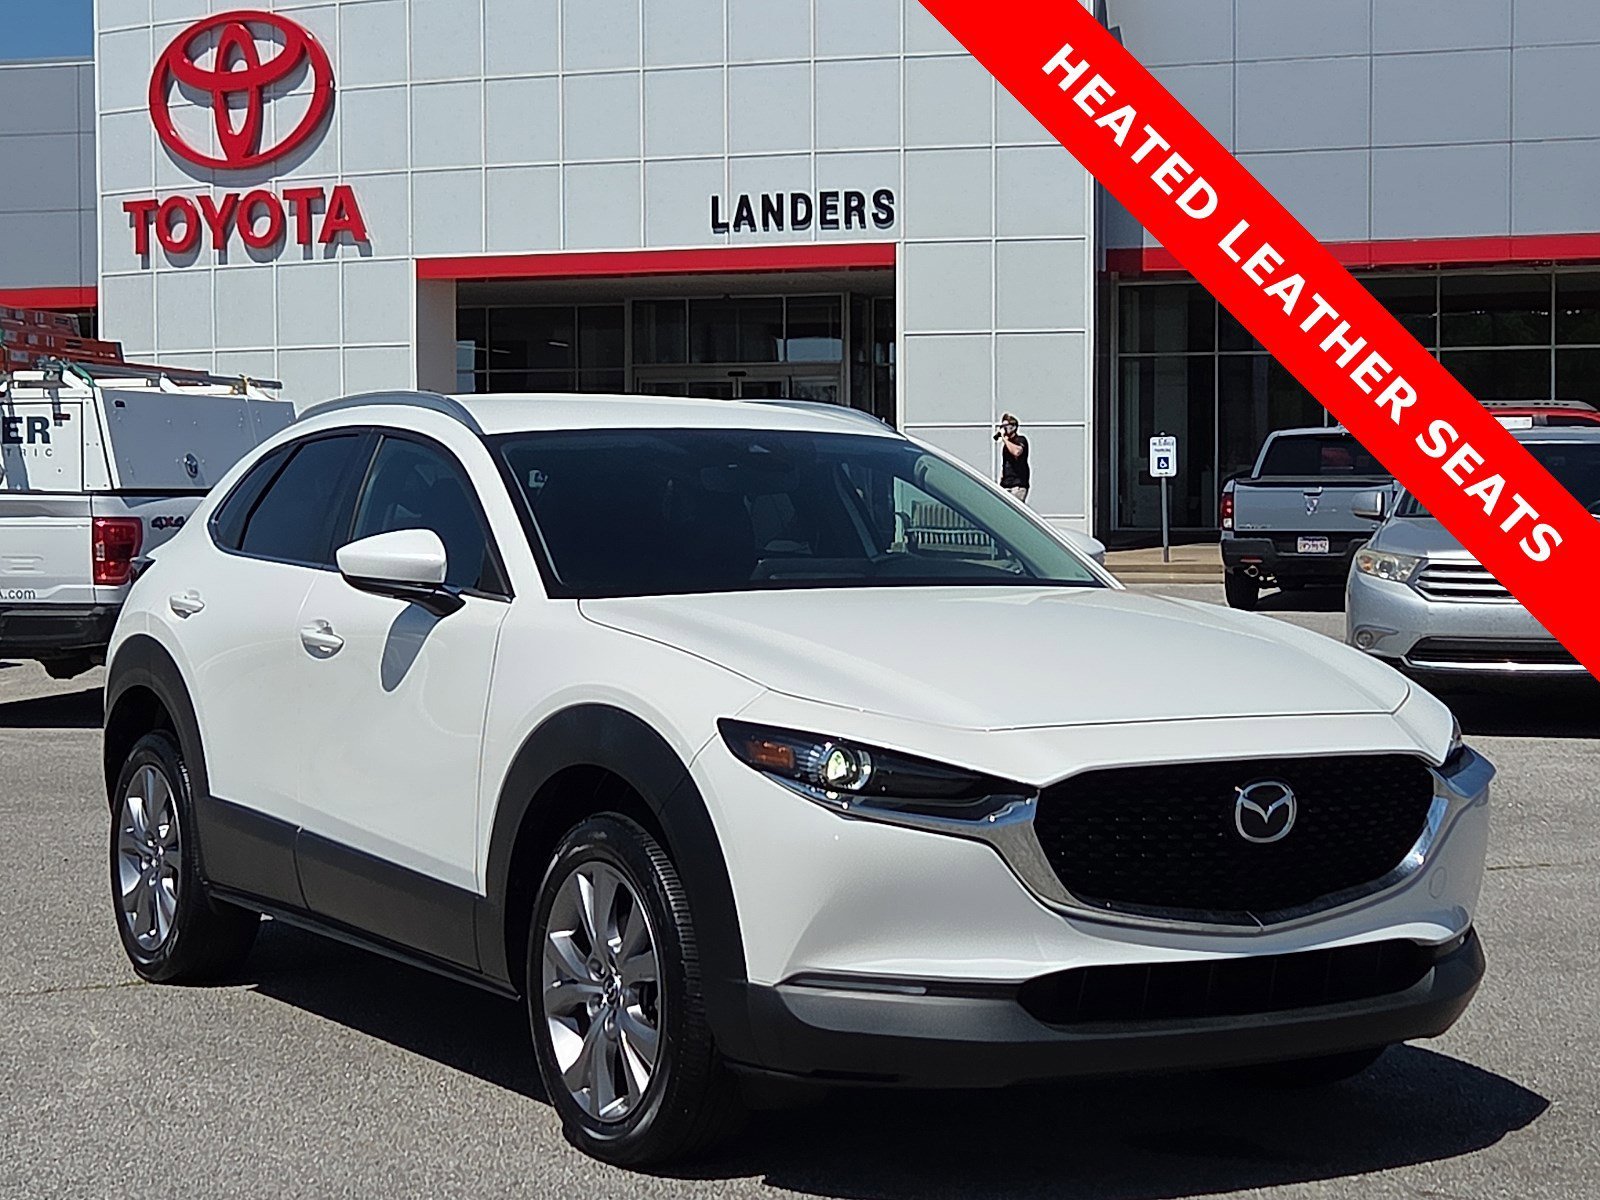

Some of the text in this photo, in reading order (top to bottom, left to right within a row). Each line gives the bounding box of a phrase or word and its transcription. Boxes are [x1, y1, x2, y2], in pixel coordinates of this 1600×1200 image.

[123, 185, 367, 254] TOYOTA
[711, 189, 895, 234] LANDERS
[2, 416, 51, 444] ER
